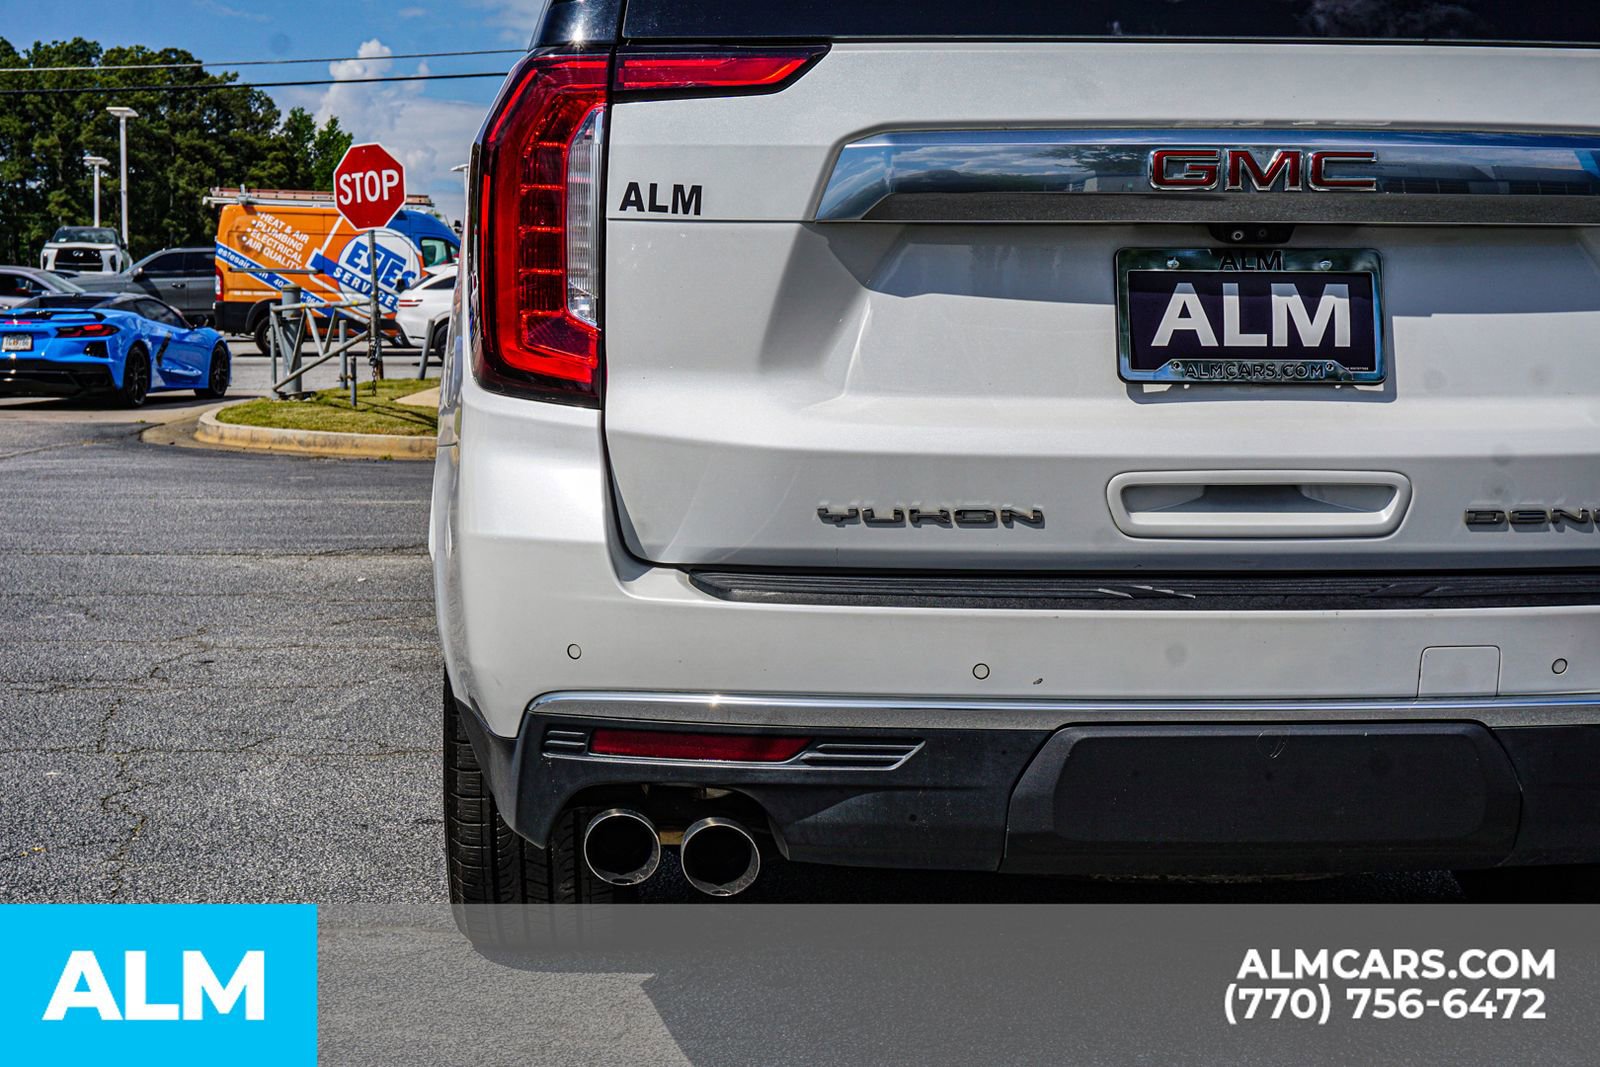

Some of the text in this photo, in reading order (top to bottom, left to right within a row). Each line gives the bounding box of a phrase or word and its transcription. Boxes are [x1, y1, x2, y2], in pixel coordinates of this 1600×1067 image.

[1149, 148, 1377, 192] GMC
[339, 169, 399, 205] STOP
[619, 182, 702, 216] ALM
[255, 221, 304, 251] PLUMBING
[260, 213, 309, 244] HEAT & AIR
[246, 238, 303, 270] AIR QUALITY
[251, 229, 303, 263] ELECTRICAL
[1218, 250, 1284, 271] ALM
[333, 267, 400, 310] SERVCE
[1151, 283, 1350, 347] ALM
[1183, 364, 1326, 379] ALMCARS.COM
[816, 503, 1044, 526] YUKON
[1464, 506, 1600, 528] DEN
